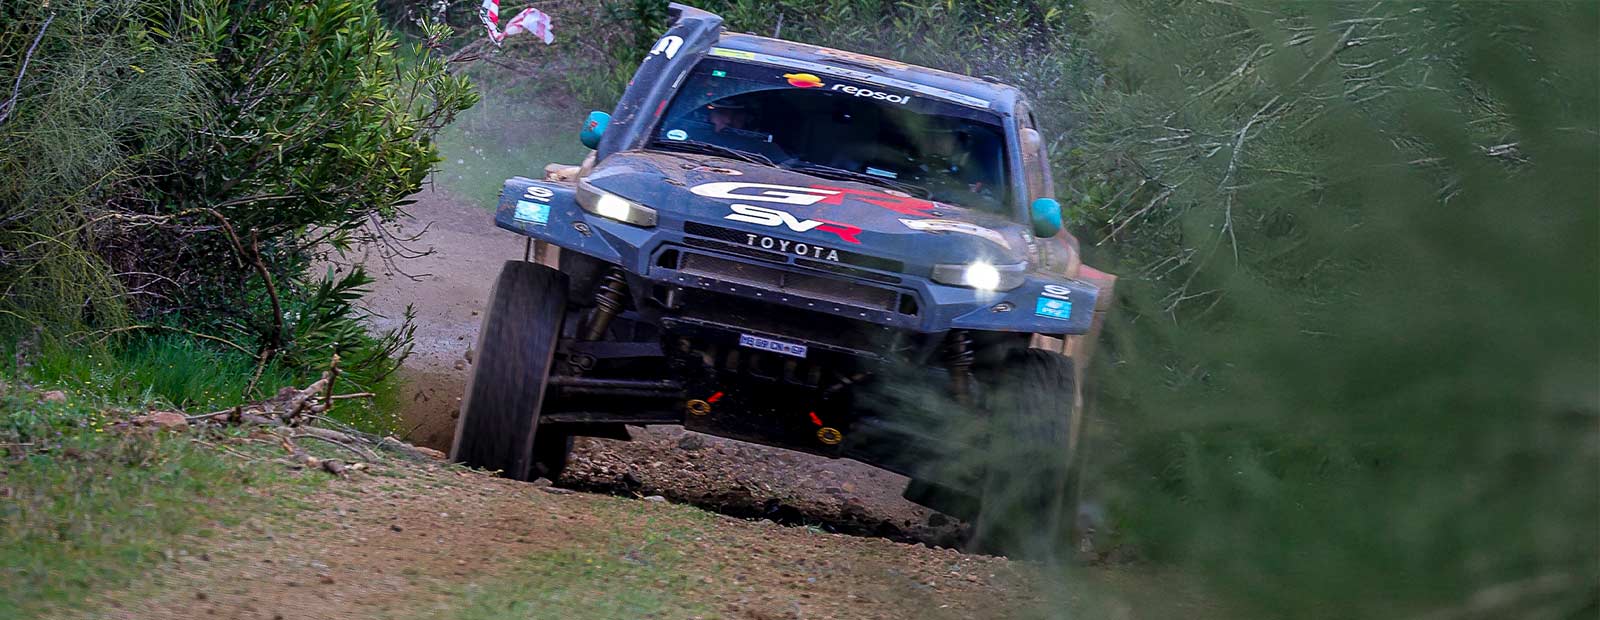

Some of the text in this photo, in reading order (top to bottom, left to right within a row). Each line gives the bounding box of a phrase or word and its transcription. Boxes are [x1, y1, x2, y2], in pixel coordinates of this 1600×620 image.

[831, 84, 911, 104] repsol
[690, 181, 936, 218] GR
[724, 203, 863, 245] SVR
[746, 233, 840, 262] TOYOTA
